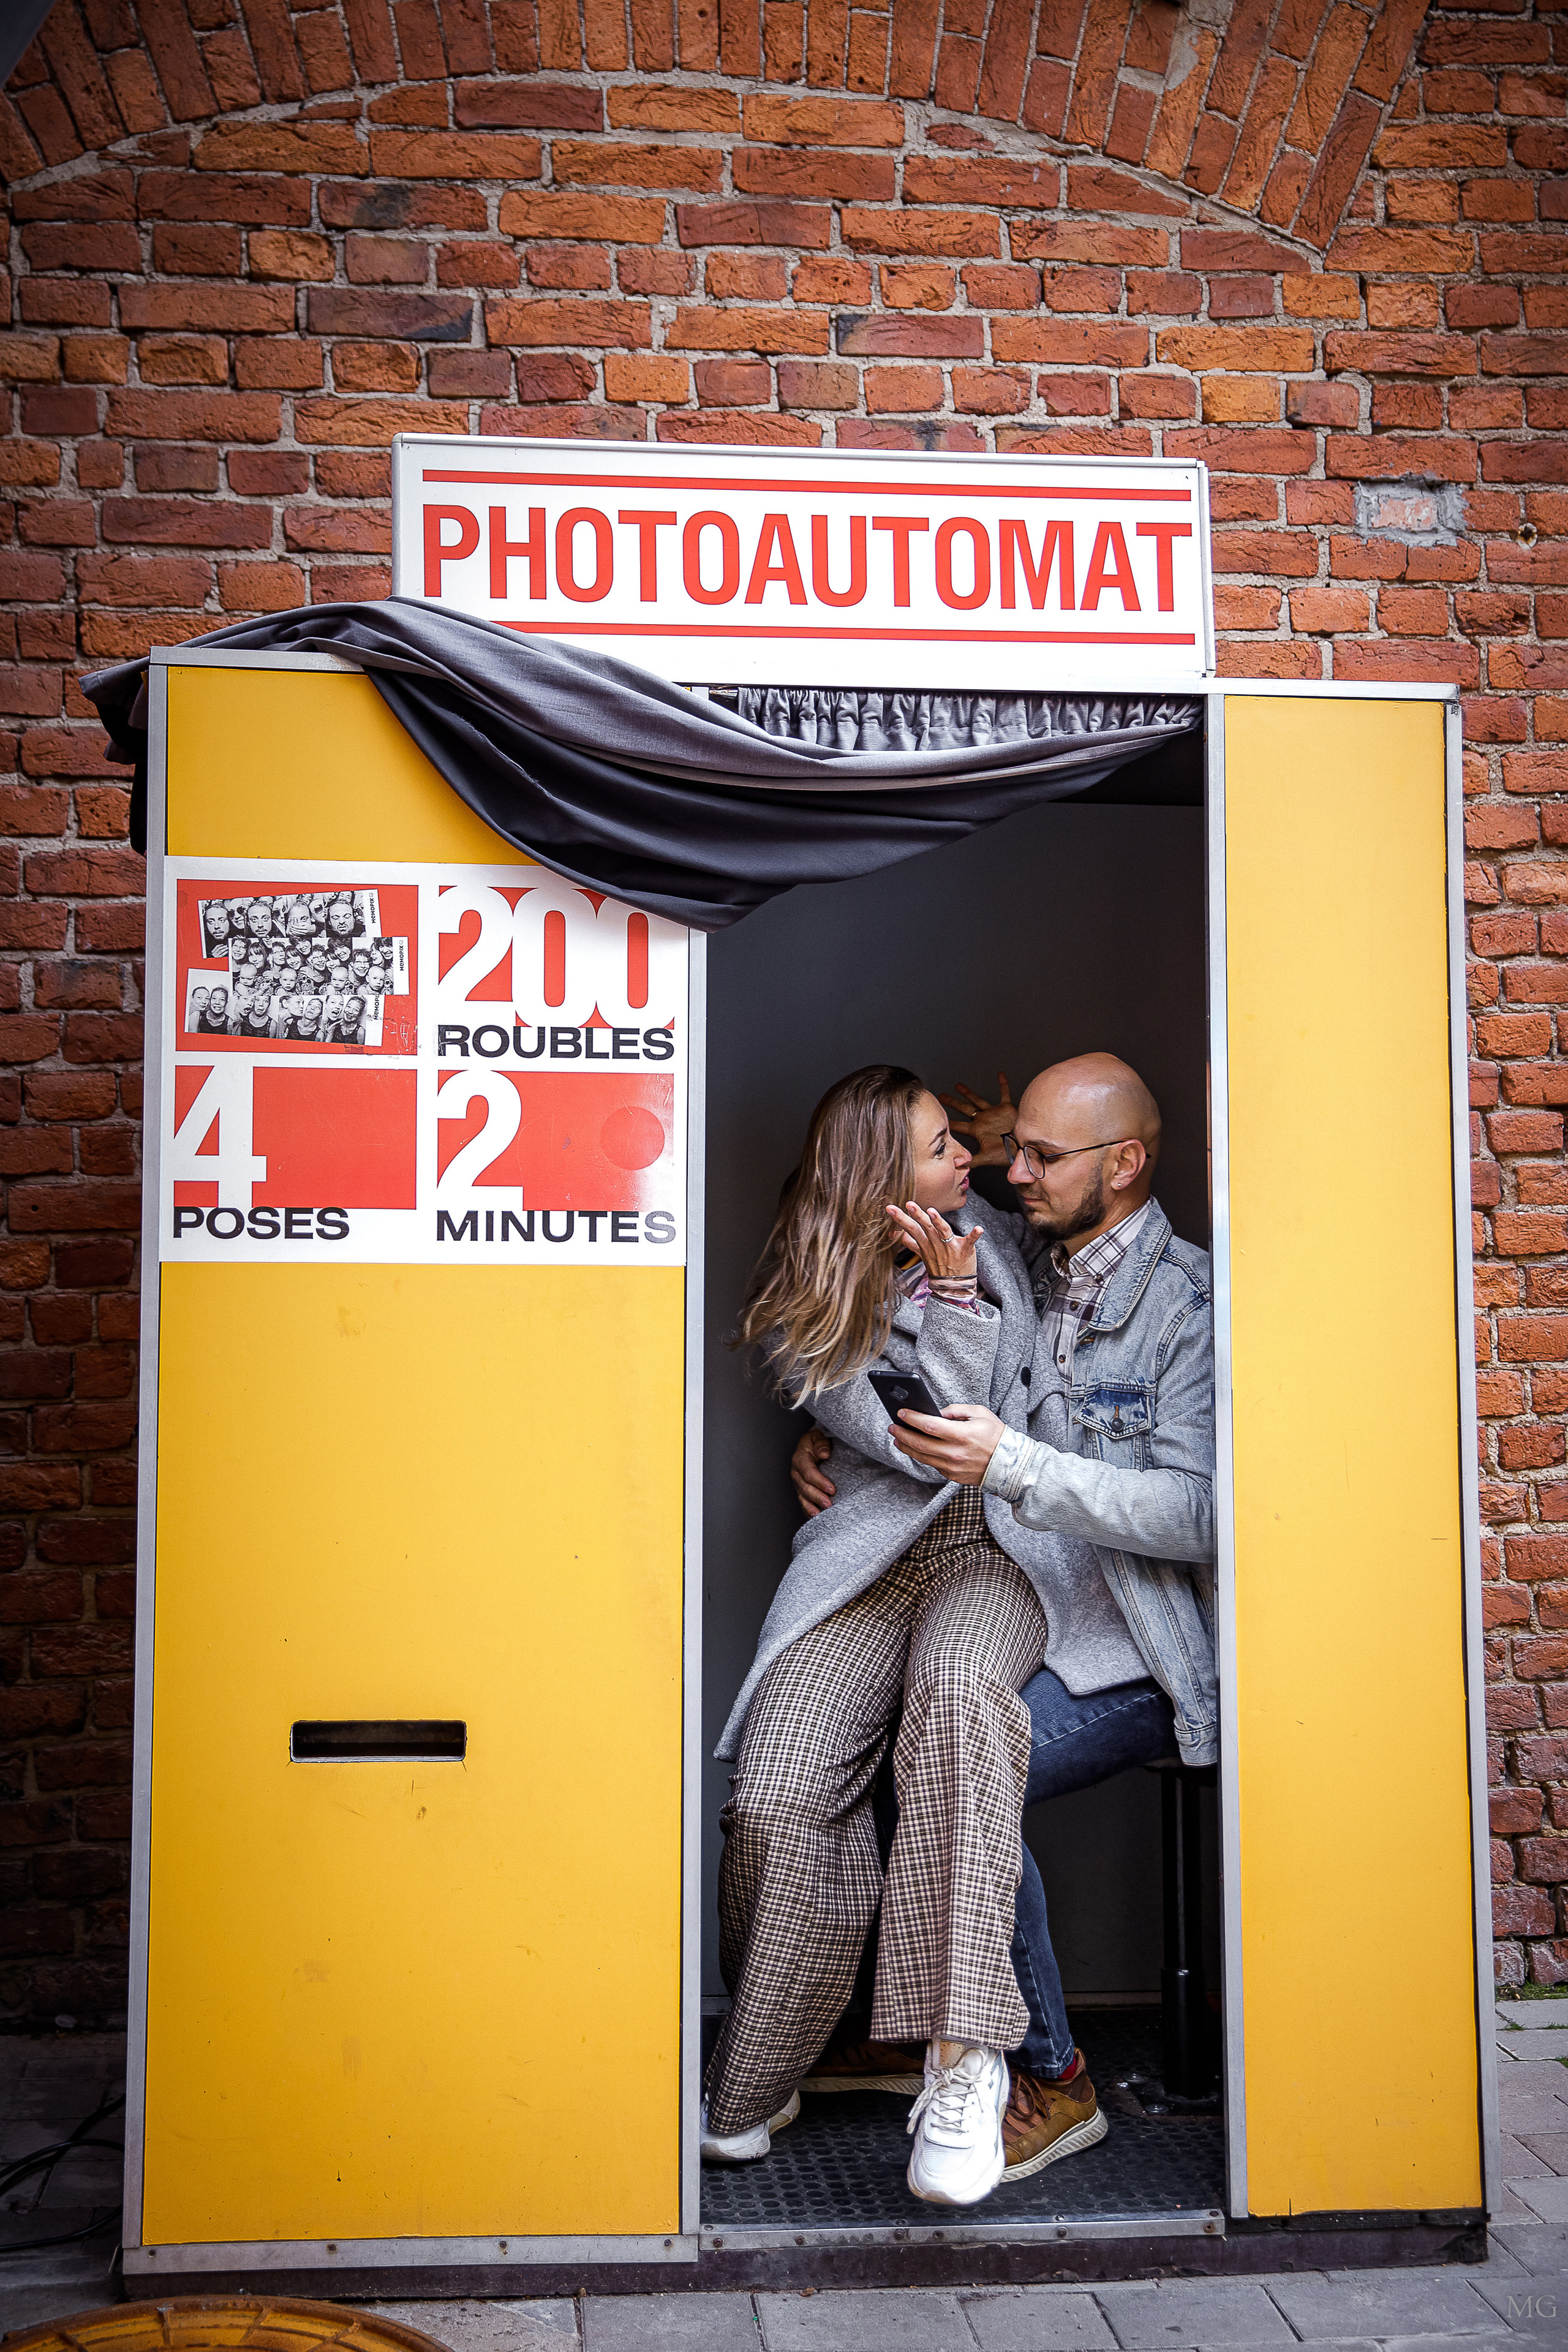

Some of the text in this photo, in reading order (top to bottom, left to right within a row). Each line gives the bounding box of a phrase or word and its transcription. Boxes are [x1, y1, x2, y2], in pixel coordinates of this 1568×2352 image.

[423, 503, 1193, 612] PHOTOAUTOMAT
[438, 886, 675, 1028] 200
[437, 1024, 675, 1061] ROUBLES
[174, 1065, 267, 1208] 4
[437, 1069, 524, 1211] 2
[173, 1206, 350, 1240] POSES
[437, 1209, 676, 1245] MINUTES
